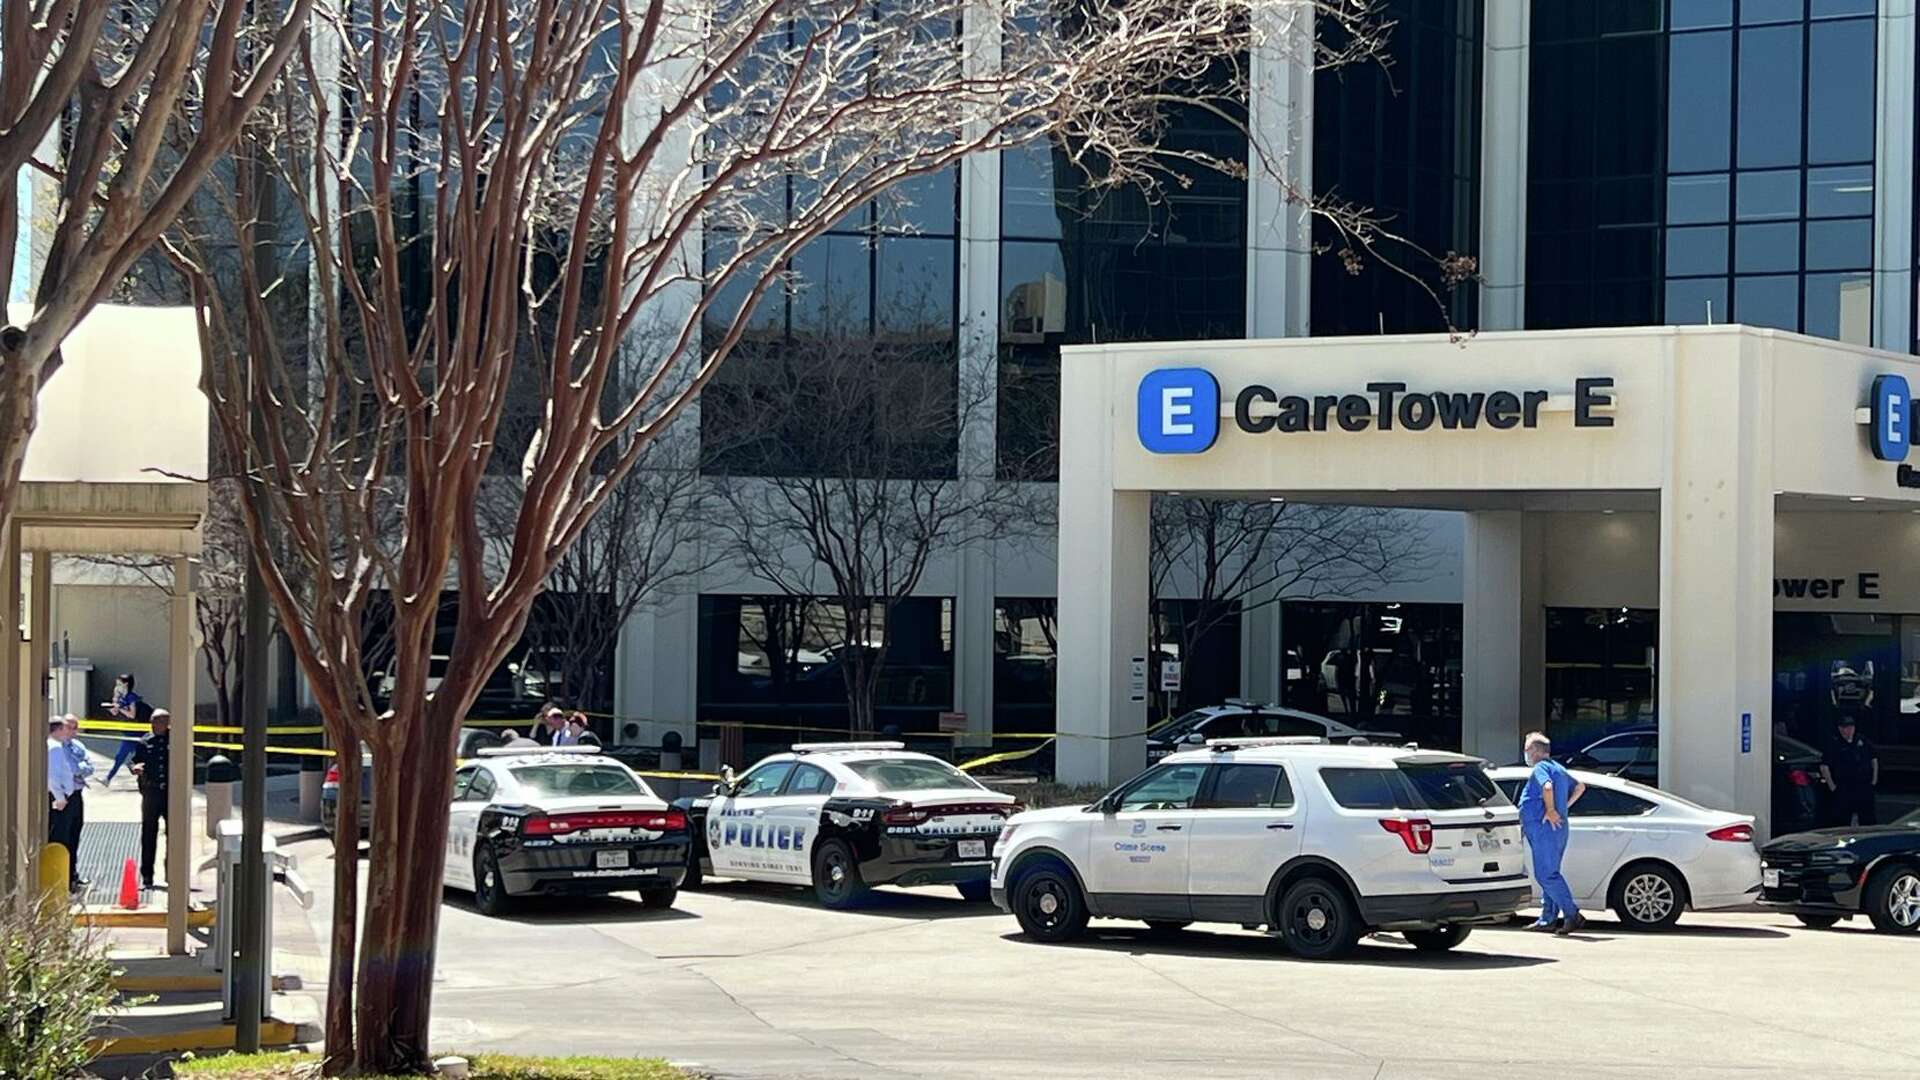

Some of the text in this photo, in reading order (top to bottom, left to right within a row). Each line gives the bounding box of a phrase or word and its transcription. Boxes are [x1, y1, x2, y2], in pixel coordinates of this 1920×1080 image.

[1162, 387, 1194, 436] E
[1234, 377, 1614, 433] CareTower E
[1887, 394, 1902, 443] E
[1858, 573, 1880, 599] E
[725, 821, 805, 851] POLICE
